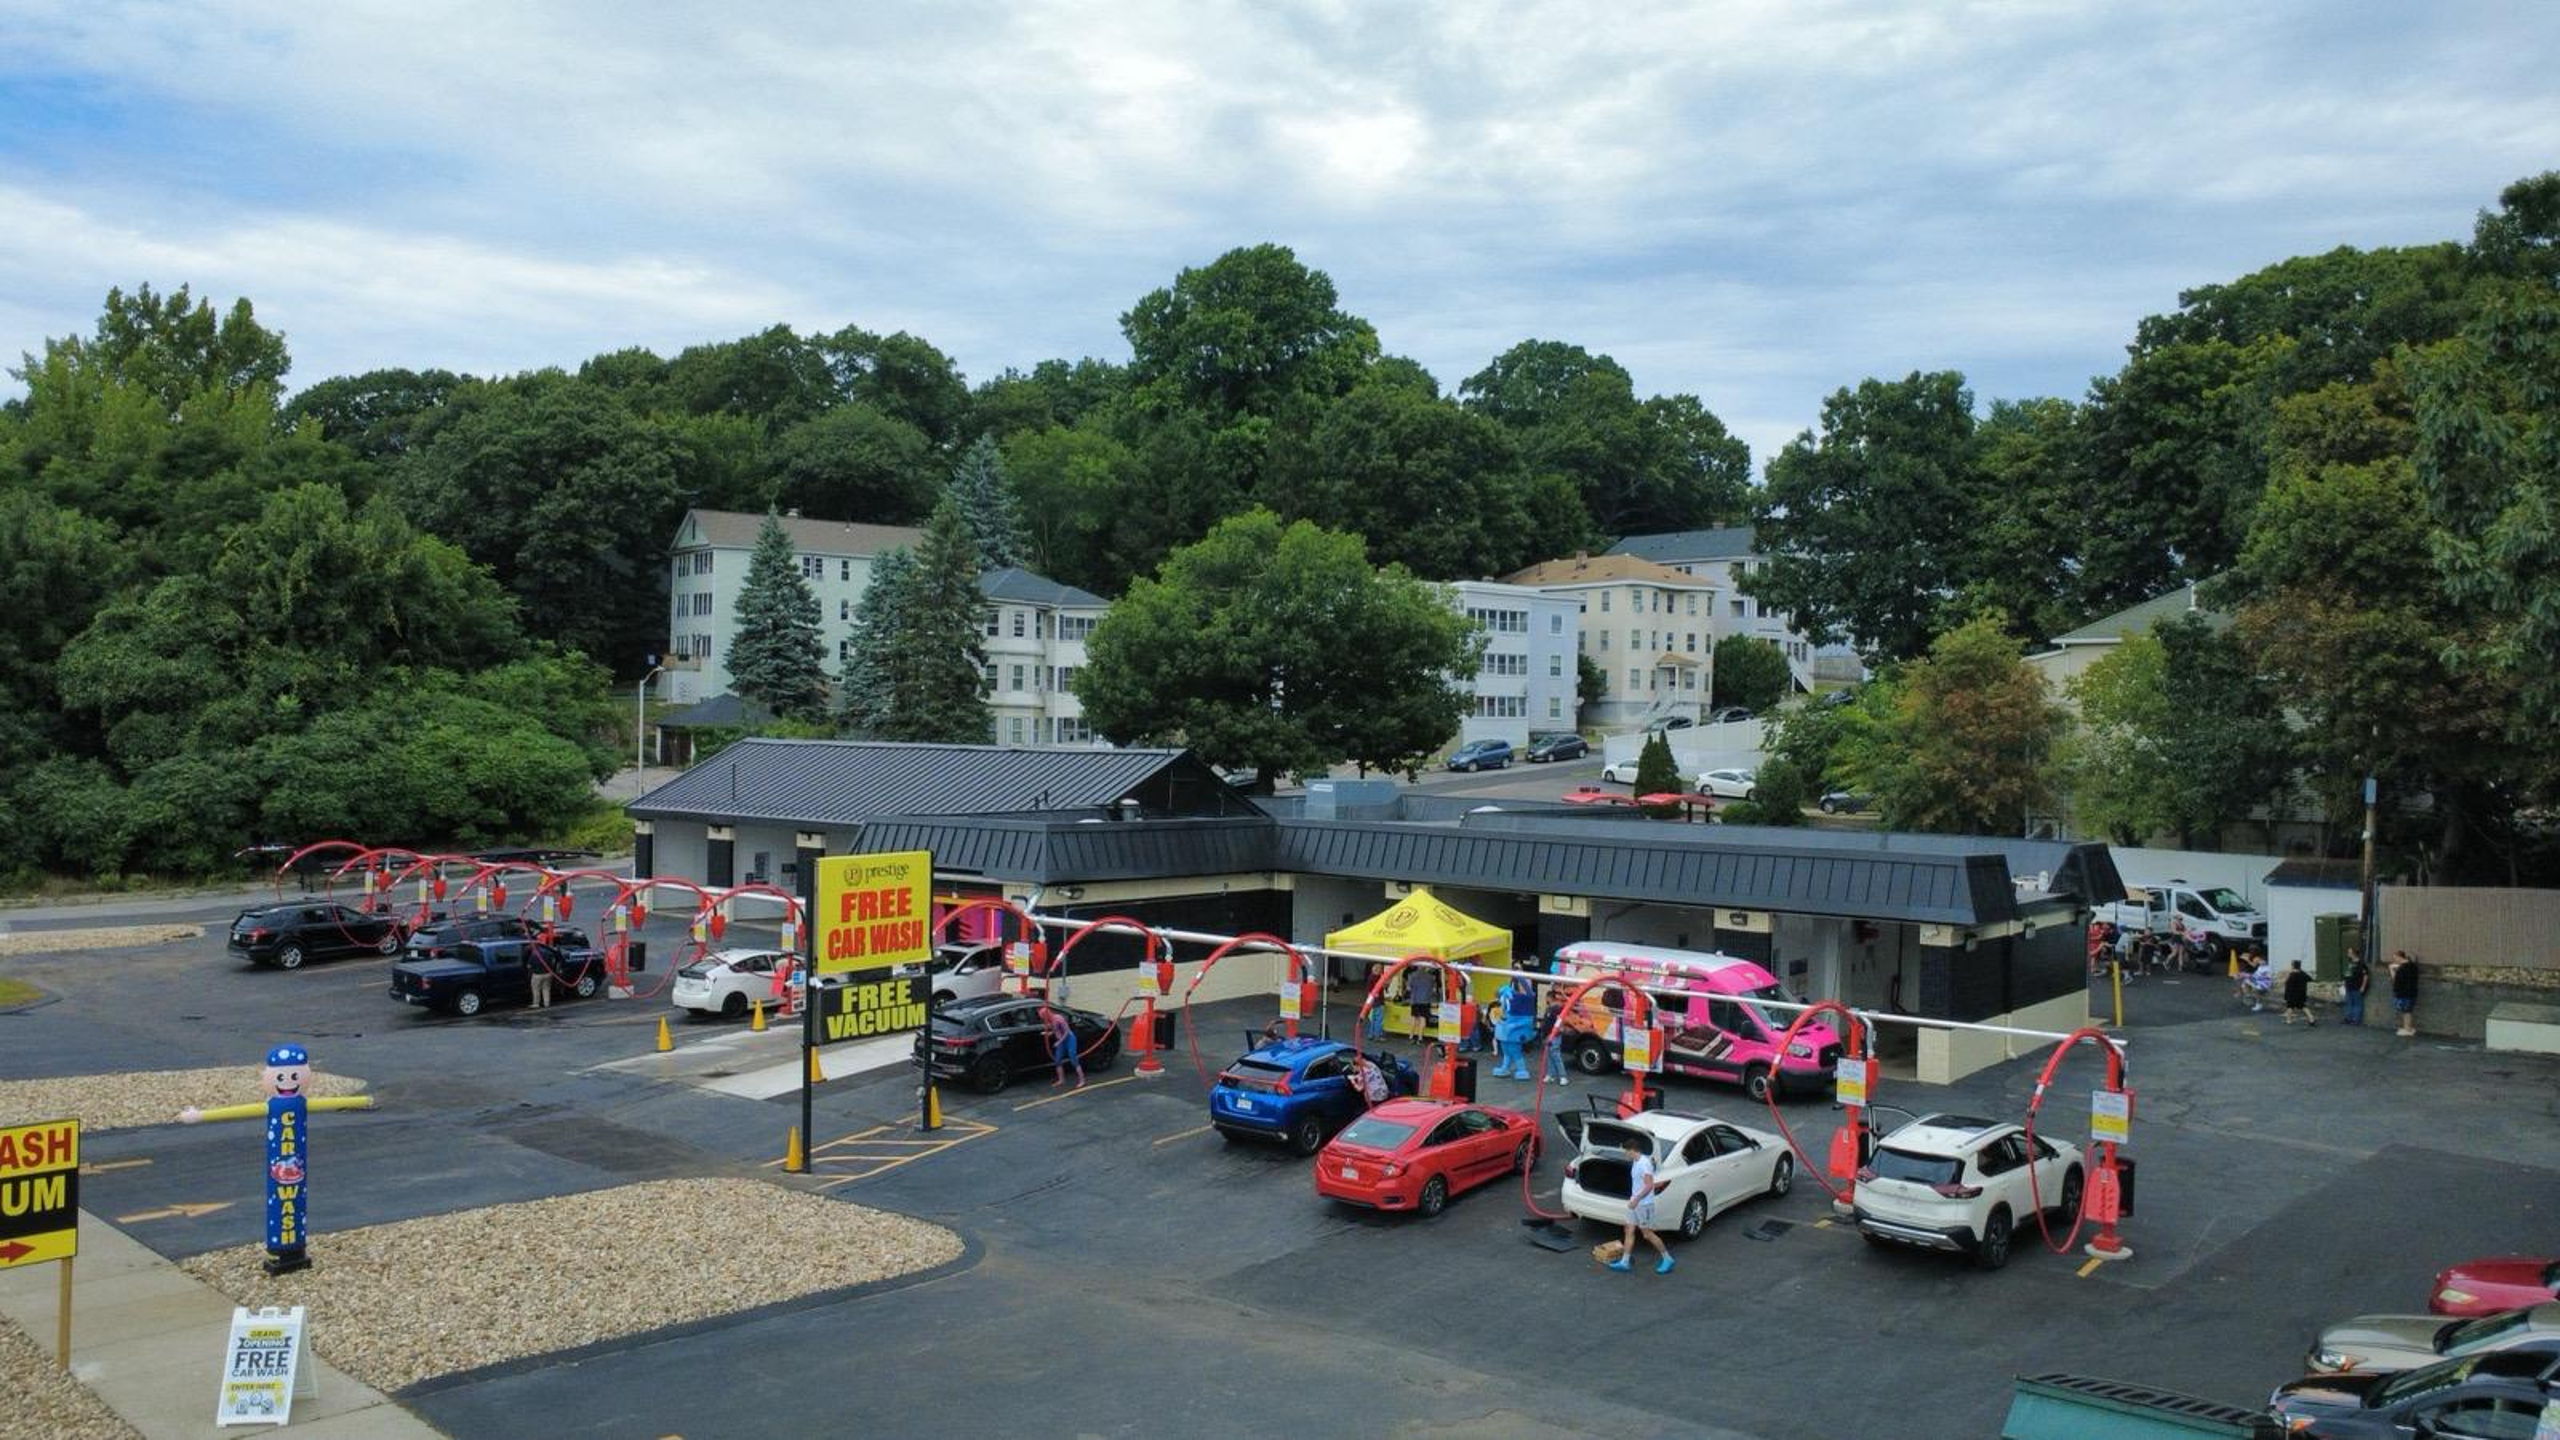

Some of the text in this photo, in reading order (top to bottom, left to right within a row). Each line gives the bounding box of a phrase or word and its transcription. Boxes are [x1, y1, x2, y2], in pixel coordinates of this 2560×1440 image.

[865, 863, 909, 884] prestige
[841, 887, 912, 923] FREE
[828, 927, 866, 961] CAR
[870, 919, 924, 955] WASH
[842, 979, 912, 1013] FREE
[826, 1003, 926, 1040] VACUUM
[277, 1112, 299, 1245] CAR WASH
[232, 1367, 289, 1377] CAR WASH
[236, 1351, 289, 1368] FREE
